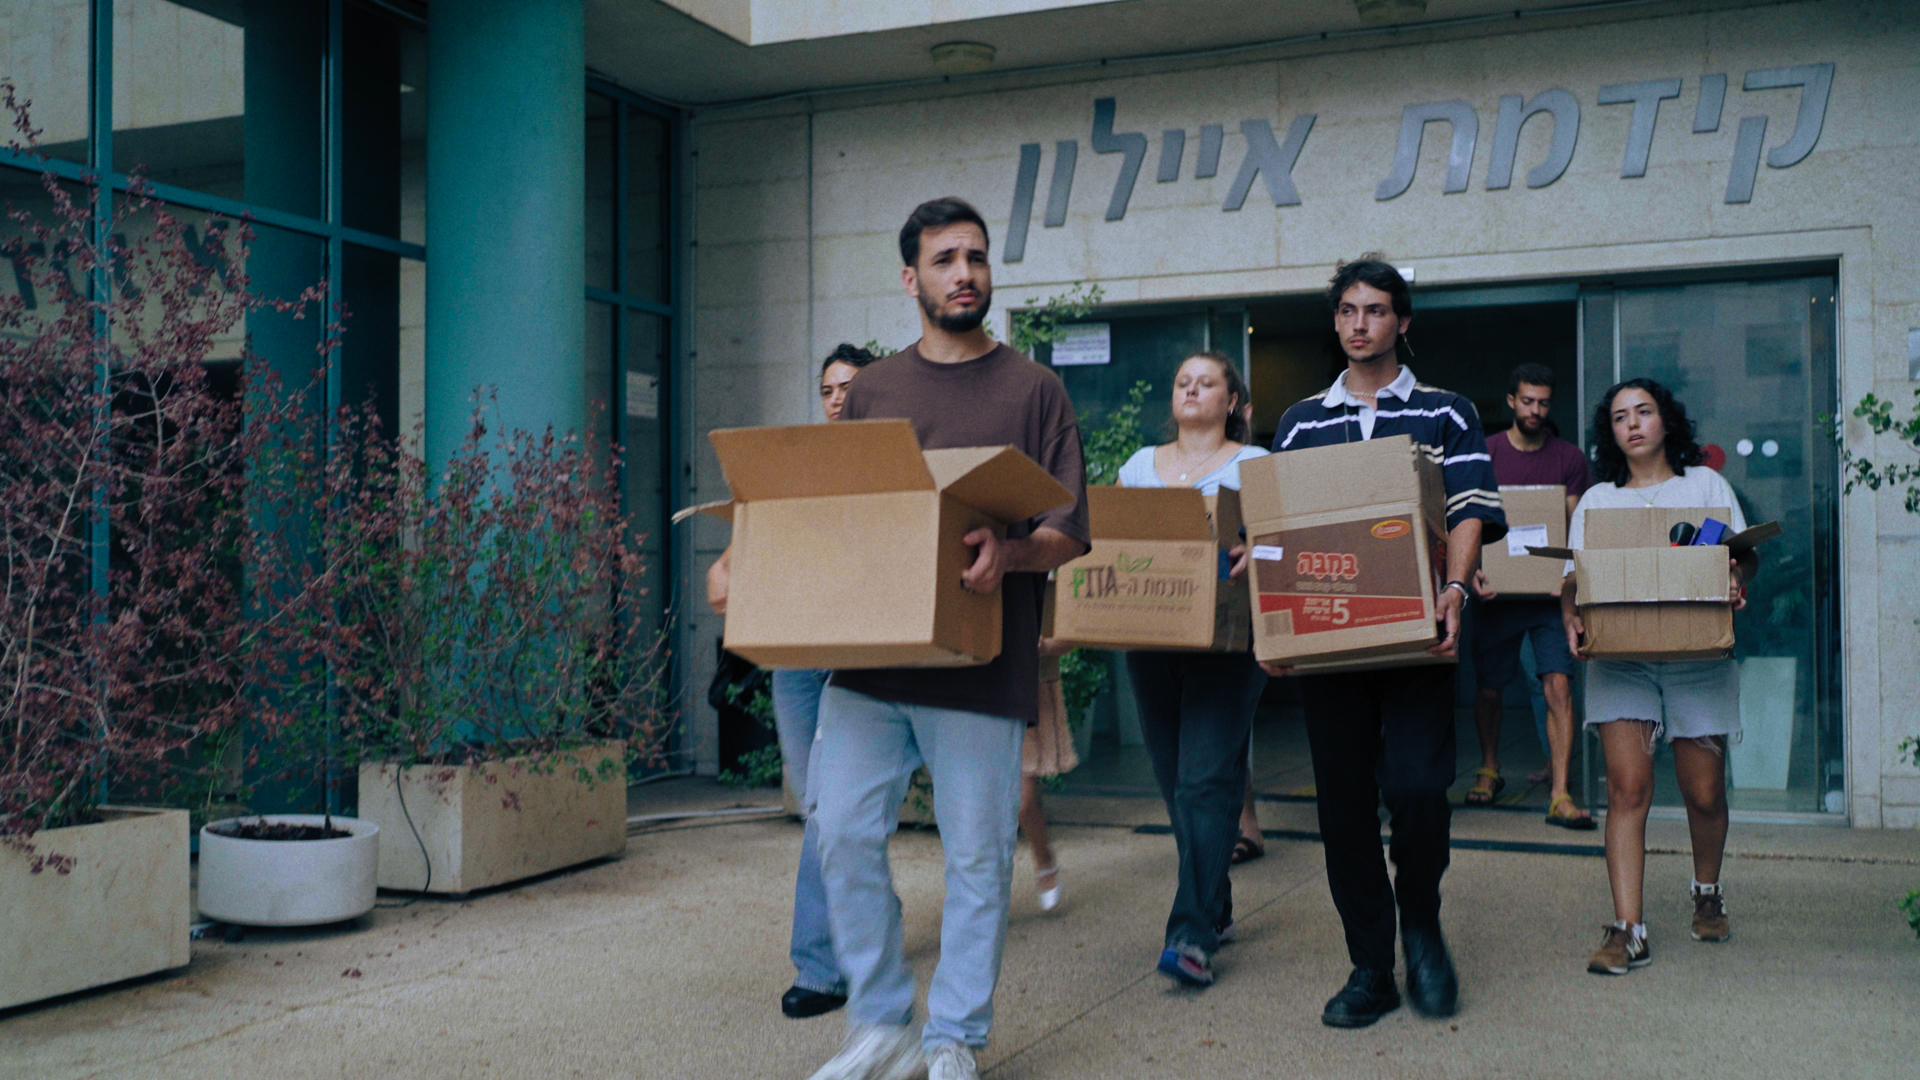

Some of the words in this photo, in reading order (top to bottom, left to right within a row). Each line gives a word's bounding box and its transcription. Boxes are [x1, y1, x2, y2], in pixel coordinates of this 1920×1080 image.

[1003, 97, 1317, 264] איילון
[1375, 62, 1835, 204] קידמת
[1332, 598, 1350, 624] 5
